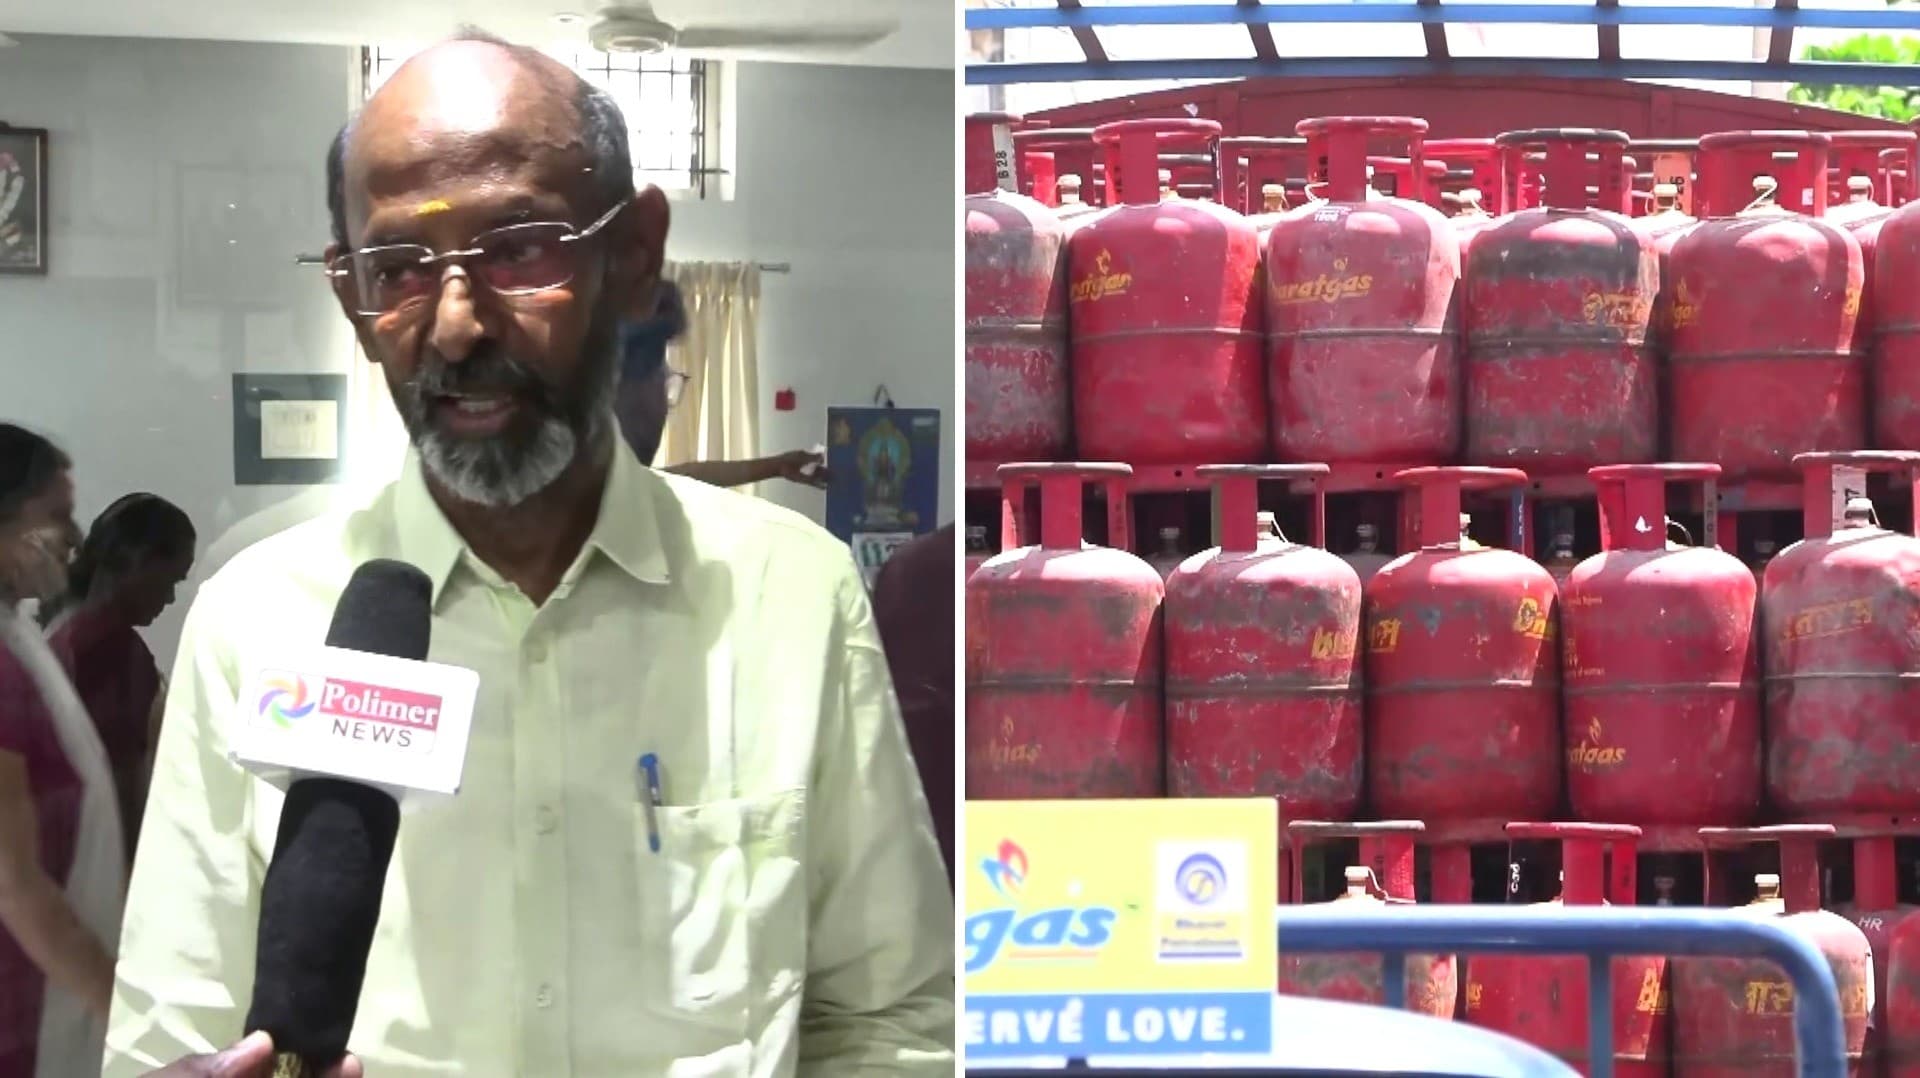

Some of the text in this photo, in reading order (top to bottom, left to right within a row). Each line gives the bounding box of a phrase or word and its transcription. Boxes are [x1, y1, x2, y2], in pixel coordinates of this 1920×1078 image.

[321, 681, 440, 726] Polimer
[332, 718, 413, 748] NEWS
[965, 906, 1116, 973] gas
[1858, 916, 1883, 932] HR
[1105, 1007, 1246, 1043] LOVE.
